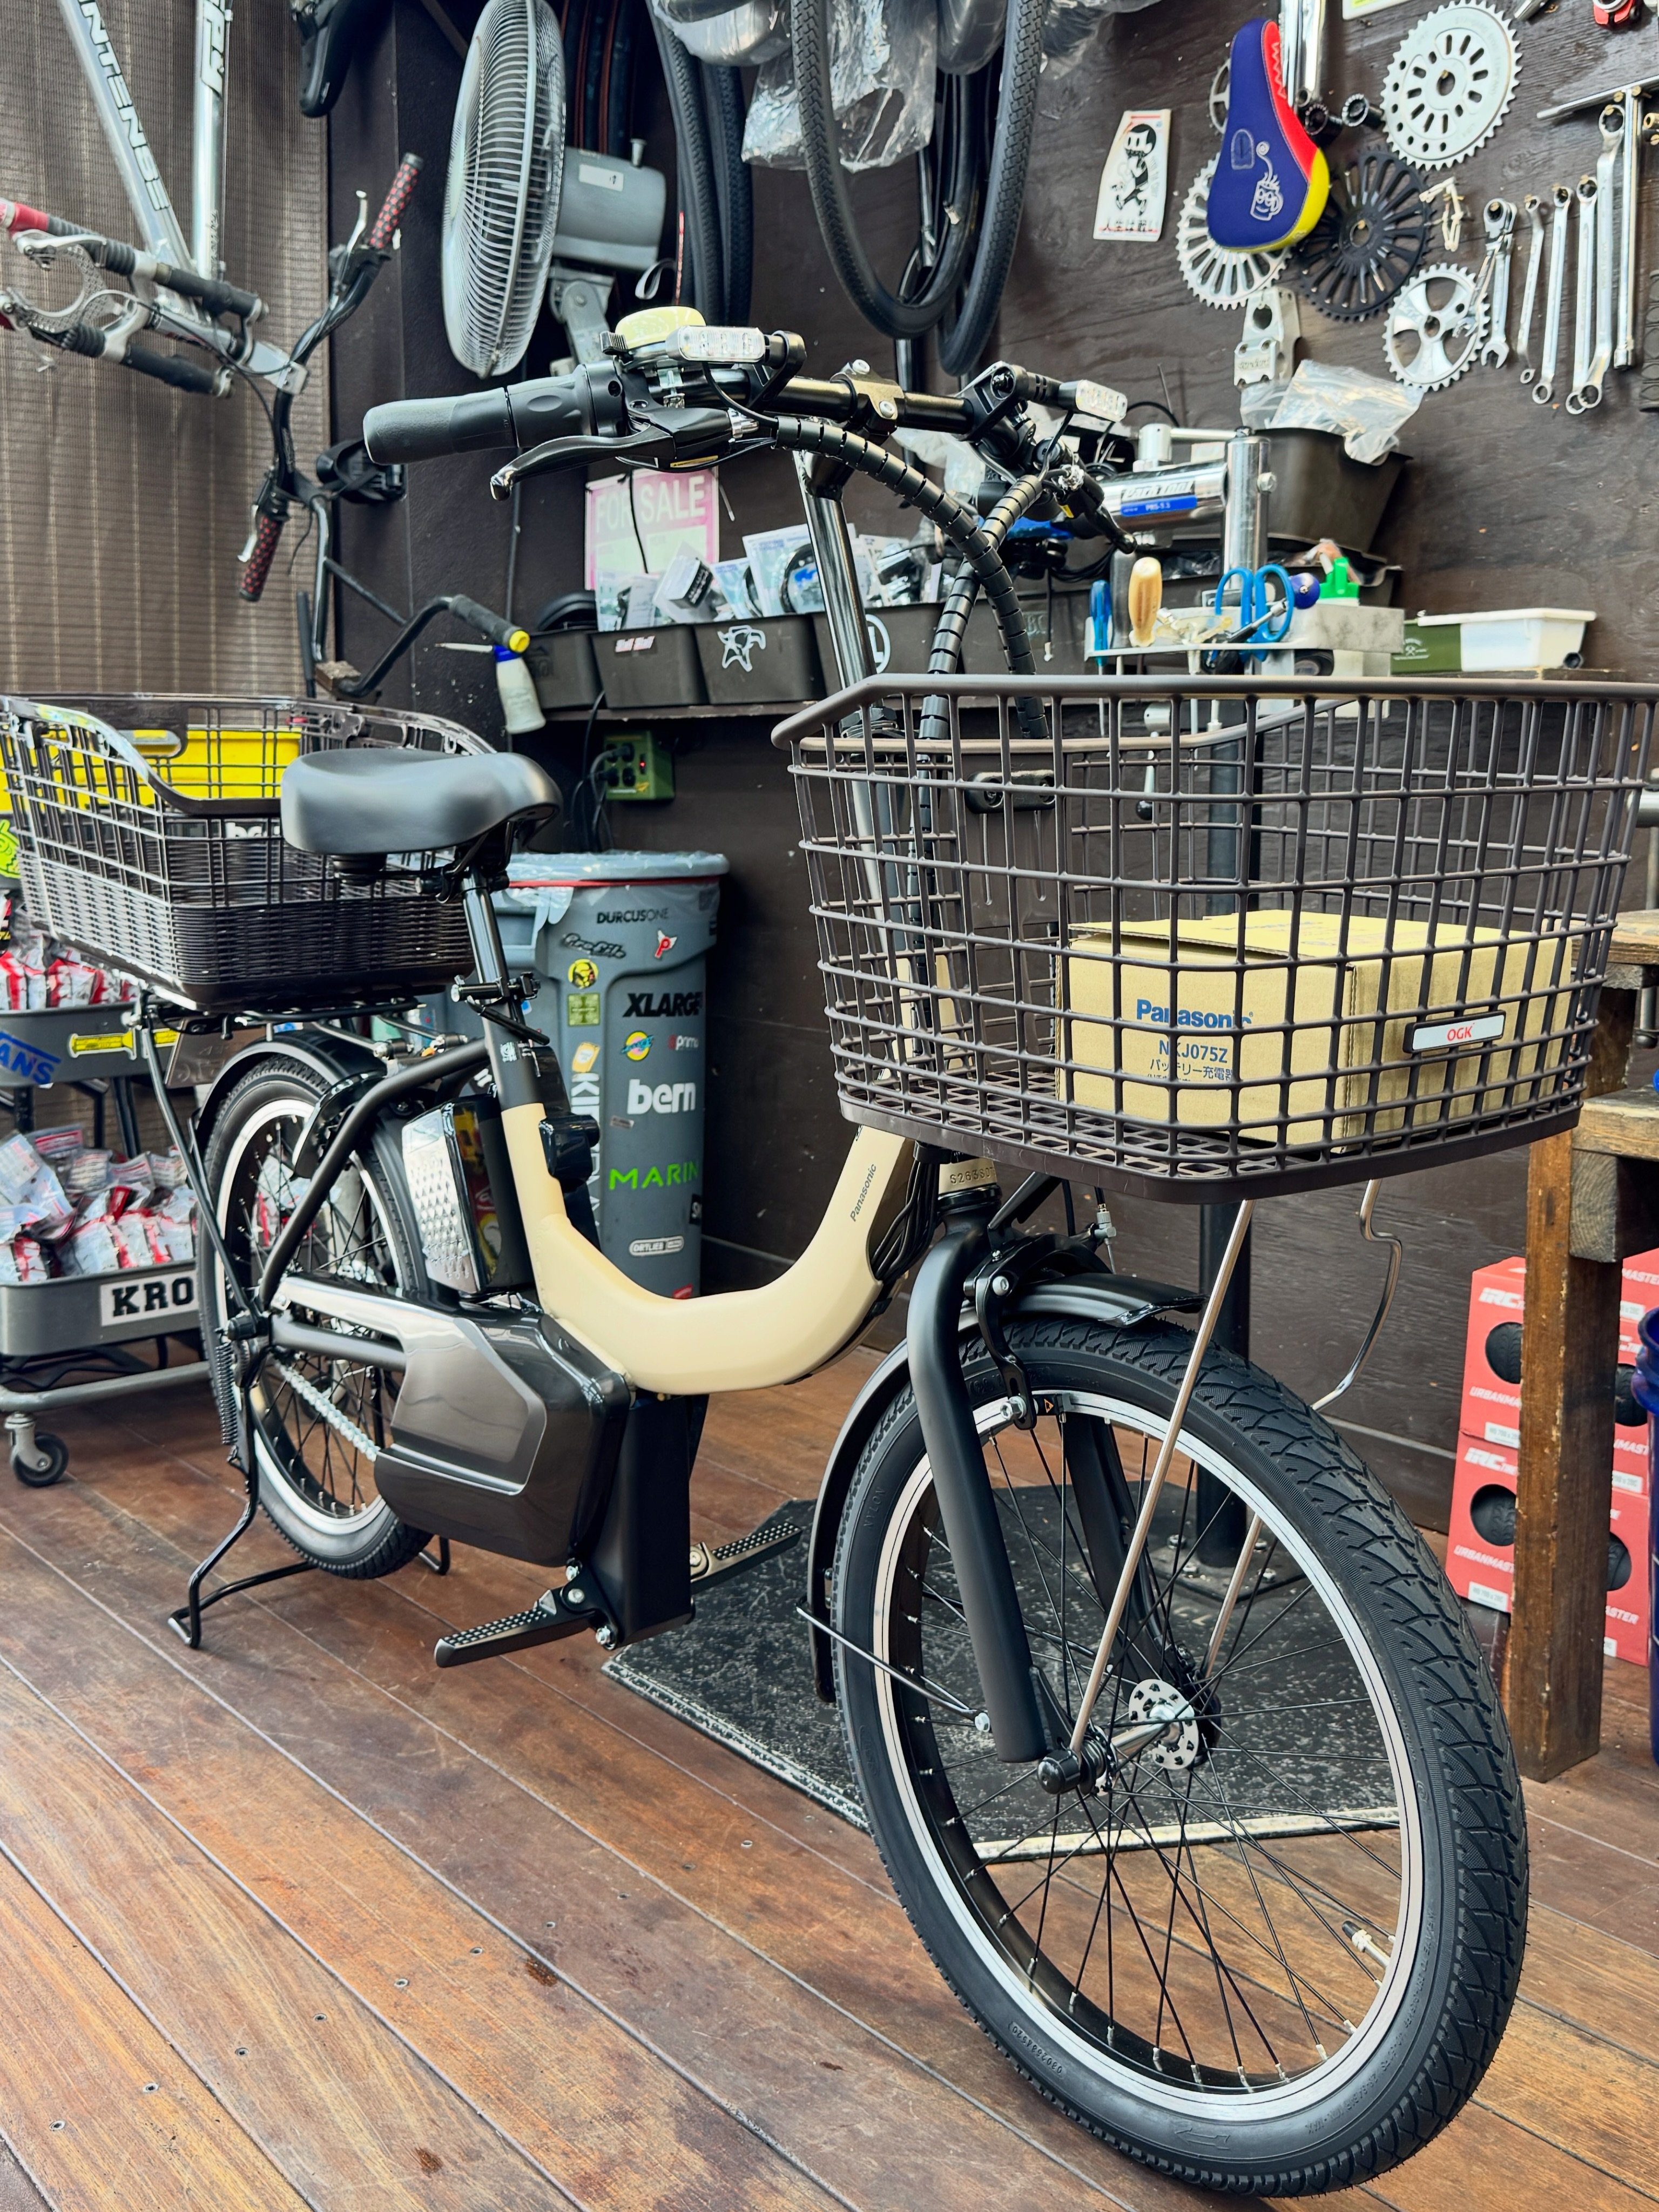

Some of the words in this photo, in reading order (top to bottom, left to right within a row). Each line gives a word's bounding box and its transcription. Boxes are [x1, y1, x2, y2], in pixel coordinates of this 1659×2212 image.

[78, 0, 170, 211] NTENSE
[595, 489, 633, 534] FOR
[639, 475, 706, 524] SALE
[622, 992, 703, 1018] XLARGE
[1447, 1025, 1473, 1042] OGK
[626, 1079, 696, 1115] bern
[609, 1162, 698, 1191] MARIN
[850, 1164, 877, 1222] Panasonic
[112, 1276, 193, 1317] KRO
